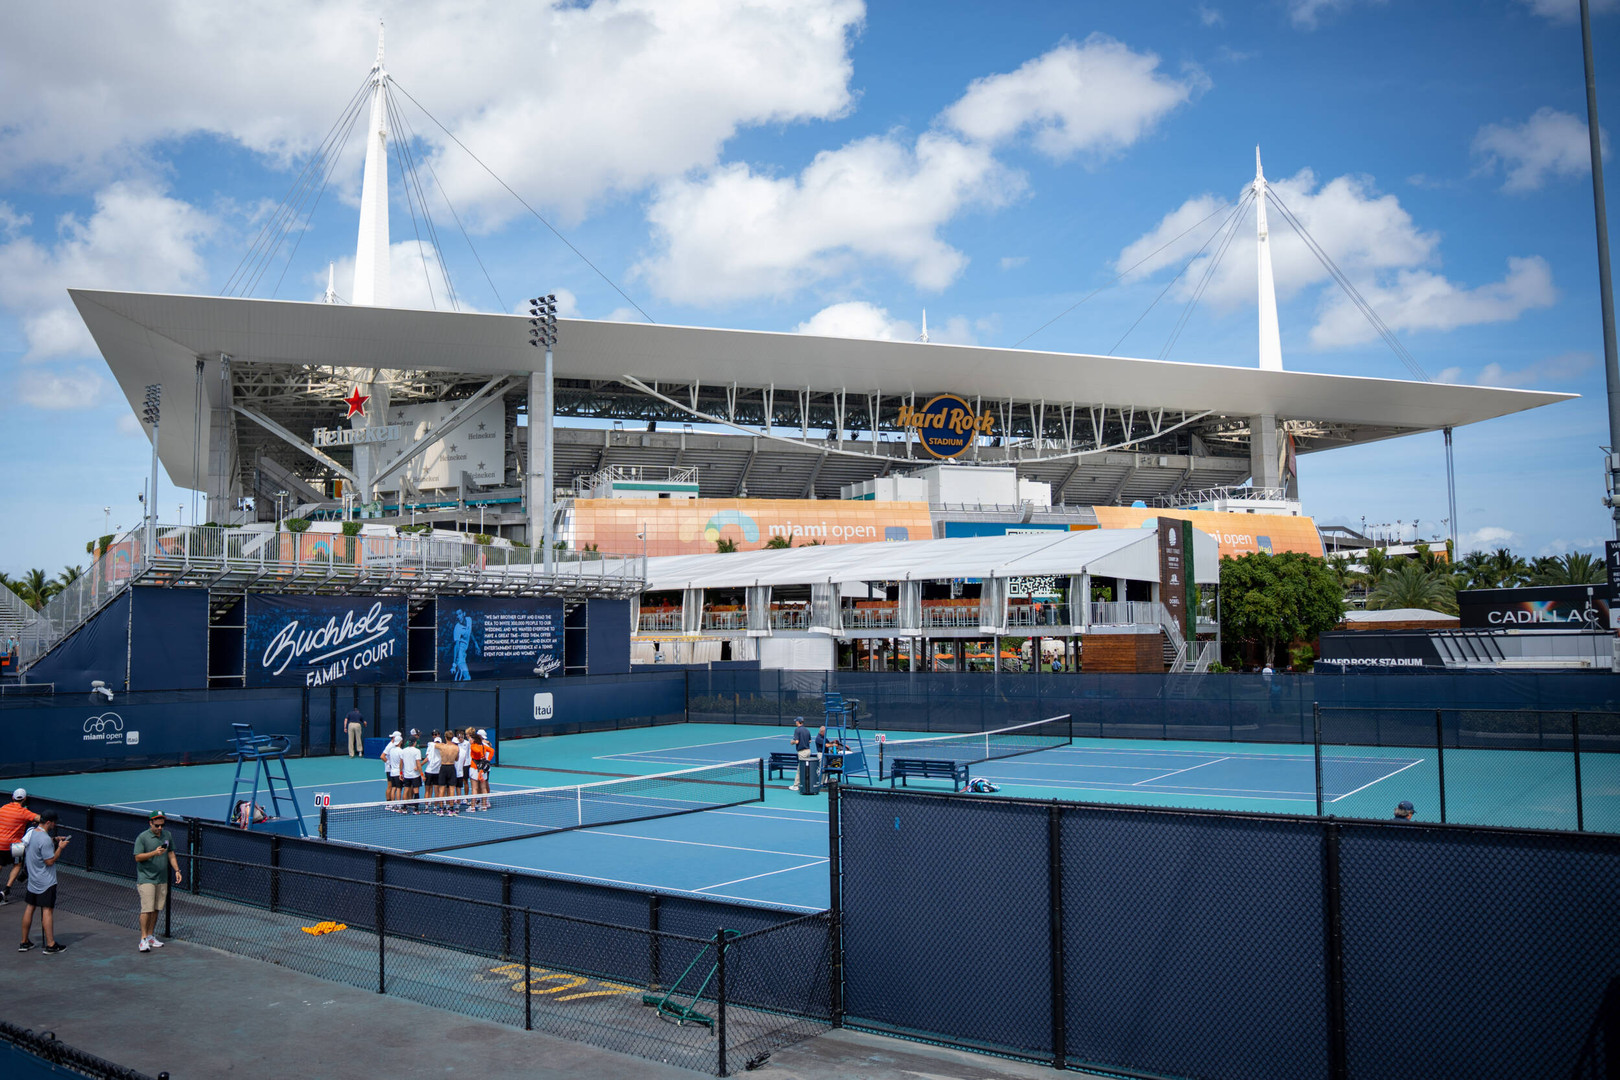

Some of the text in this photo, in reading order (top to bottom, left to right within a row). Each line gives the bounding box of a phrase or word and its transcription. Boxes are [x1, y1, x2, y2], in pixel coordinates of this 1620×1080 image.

[897, 405, 995, 435] Hard Rock
[313, 425, 401, 448] Heineken
[468, 431, 496, 441] Heineken
[928, 437, 963, 446] STADIUM
[768, 521, 876, 541] miami open
[1223, 533, 1253, 547] open
[1487, 609, 1600, 624] CADILLAC
[262, 601, 394, 676] Buchholz
[306, 638, 396, 688] FAMILY COURT
[1353, 658, 1379, 666] ROCK
[1379, 658, 1423, 666] STADIUM
[535, 705, 552, 716] Itaú
[83, 733, 123, 741] miami open
[315, 795, 330, 806] 0 0
